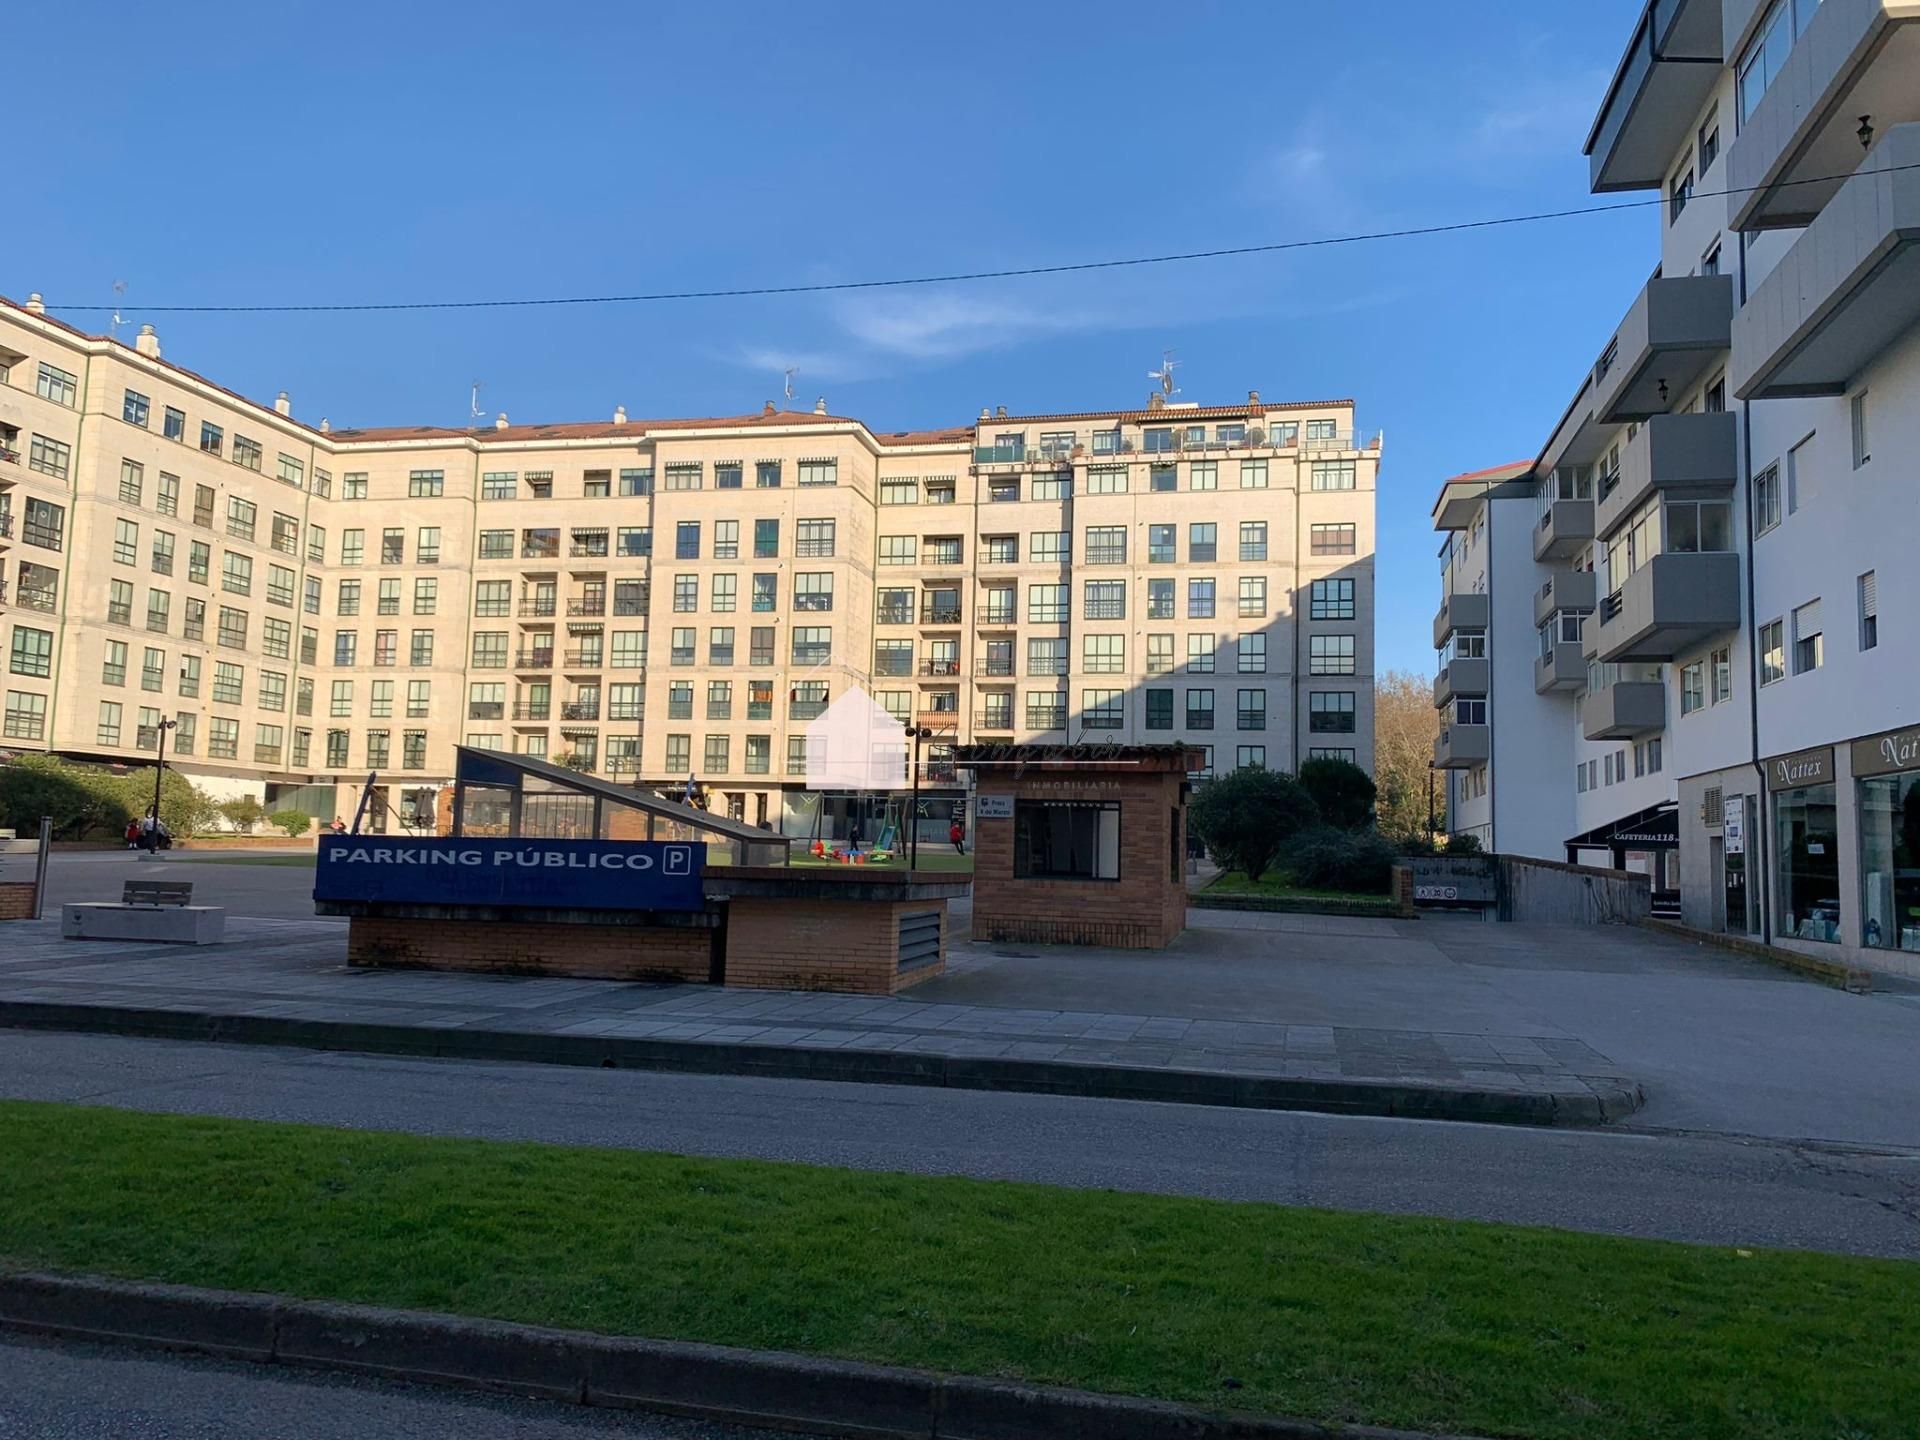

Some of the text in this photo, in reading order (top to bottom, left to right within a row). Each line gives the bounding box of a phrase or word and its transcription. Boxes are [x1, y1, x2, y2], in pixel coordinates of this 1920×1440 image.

[1777, 759, 1821, 785] Nattex
[1614, 833, 1656, 841] CAFETERIA
[1656, 833, 1675, 842] 118
[329, 846, 684, 870] PARKING PÚBLICO P
